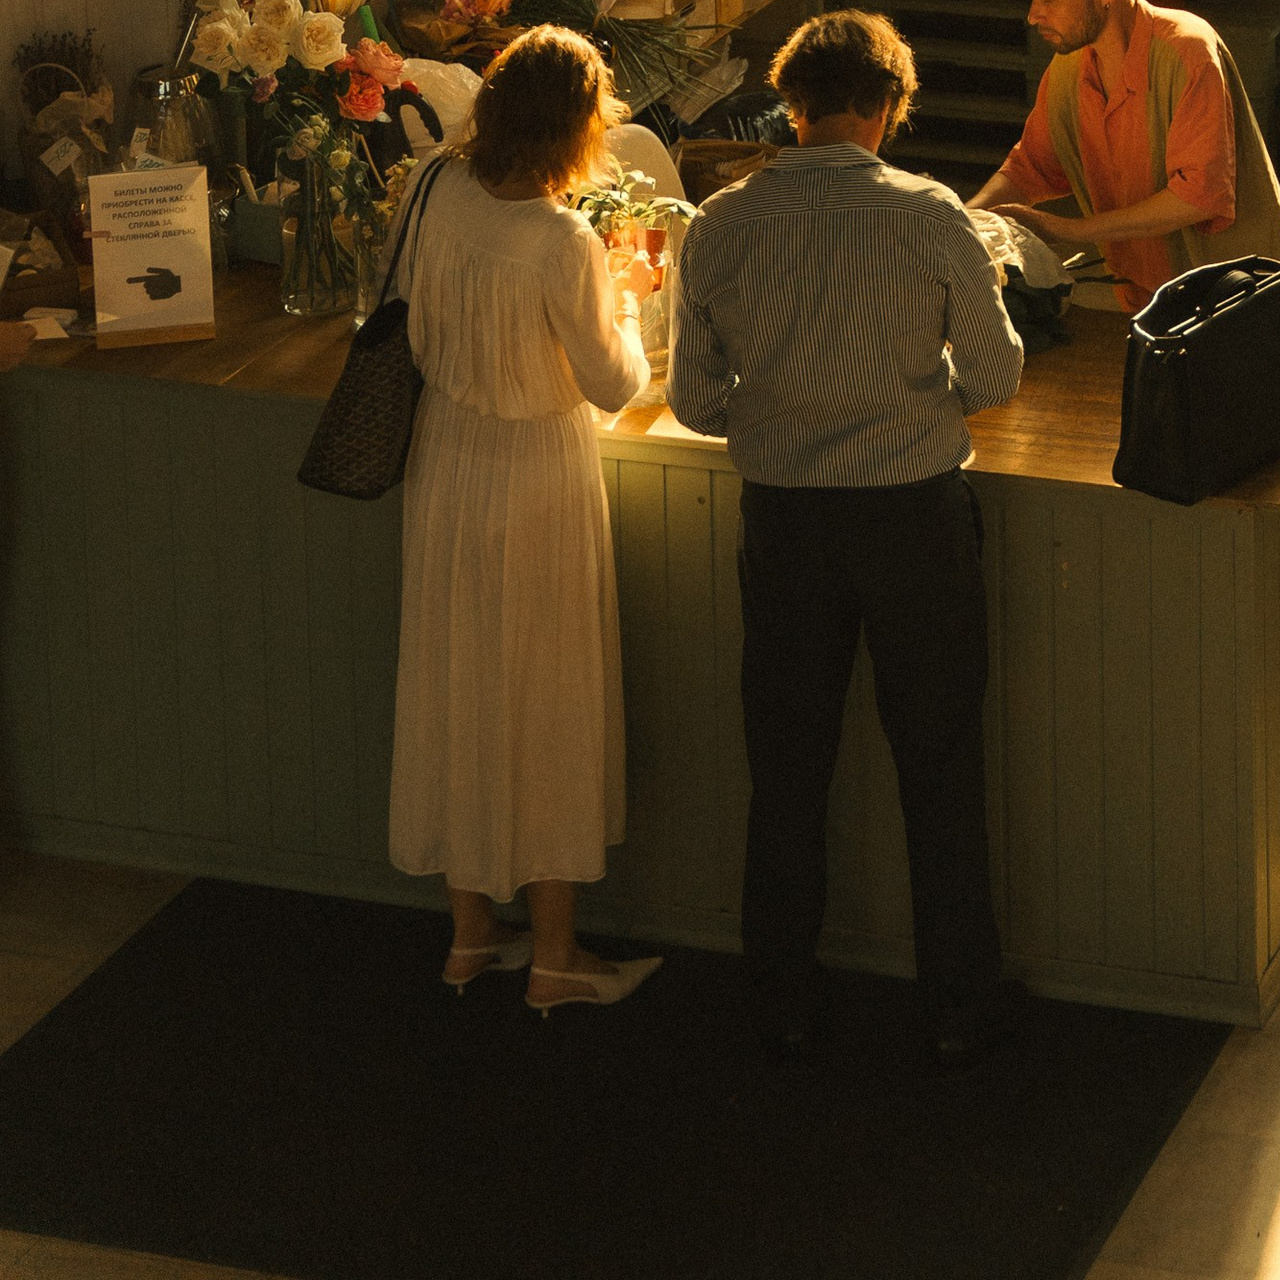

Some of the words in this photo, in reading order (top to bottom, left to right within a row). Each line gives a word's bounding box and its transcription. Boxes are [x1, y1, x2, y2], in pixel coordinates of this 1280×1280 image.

[114, 188, 147, 197] БИЛЕТЫ
[149, 183, 183, 194] МОЖНО
[101, 198, 155, 210] ПРИОБРЕСТИ
[169, 194, 197, 203] КАССЕ,
[112, 205, 187, 220] РАСПОЛОЖЕННОЙ
[128, 220, 160, 230] СПРАВА
[162, 218, 172, 226] ЗА
[106, 230, 160, 243] СТЕКЛЯННОЙ
[162, 227, 196, 239] ДВЕРЬЮ
